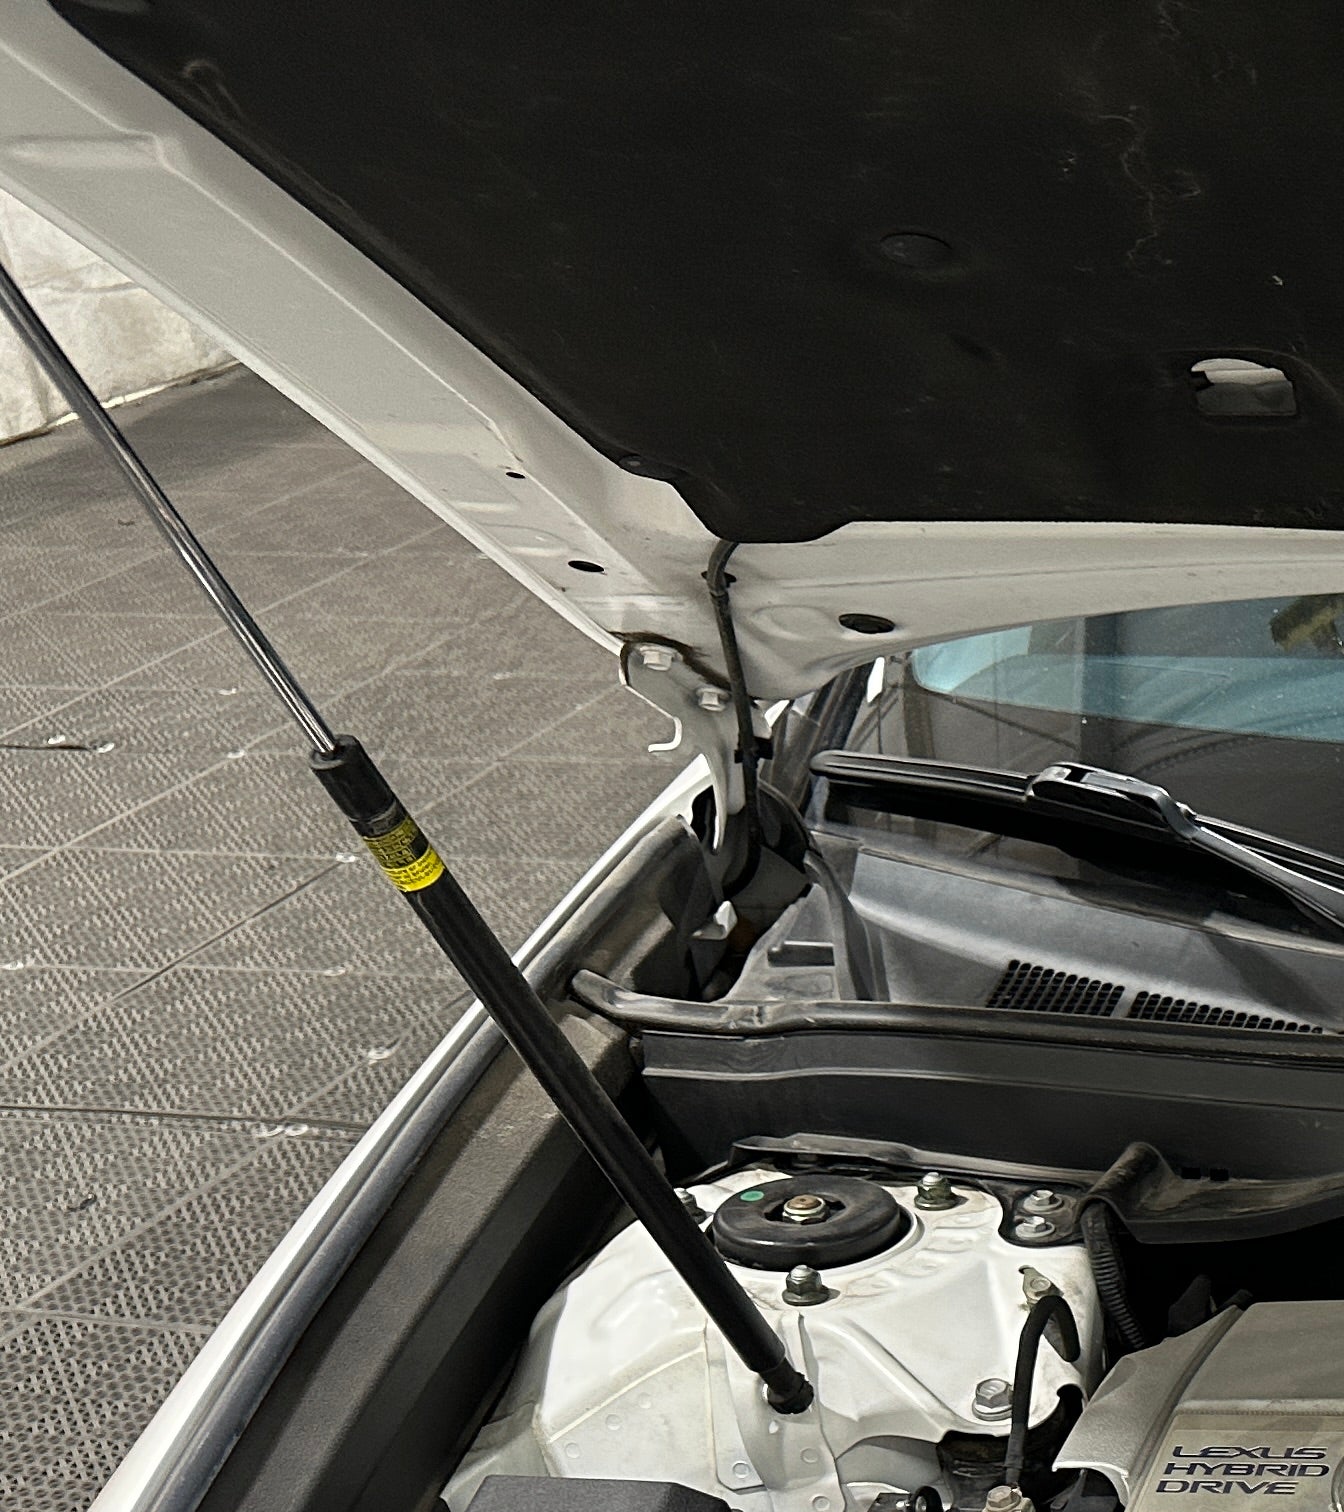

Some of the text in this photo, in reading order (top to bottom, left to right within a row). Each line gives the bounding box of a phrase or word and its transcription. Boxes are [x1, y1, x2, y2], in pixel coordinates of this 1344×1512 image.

[1172, 1445, 1328, 1460] LEXUS
[1163, 1461, 1330, 1478] HYBRID
[1155, 1479, 1300, 1495] DRIVE
